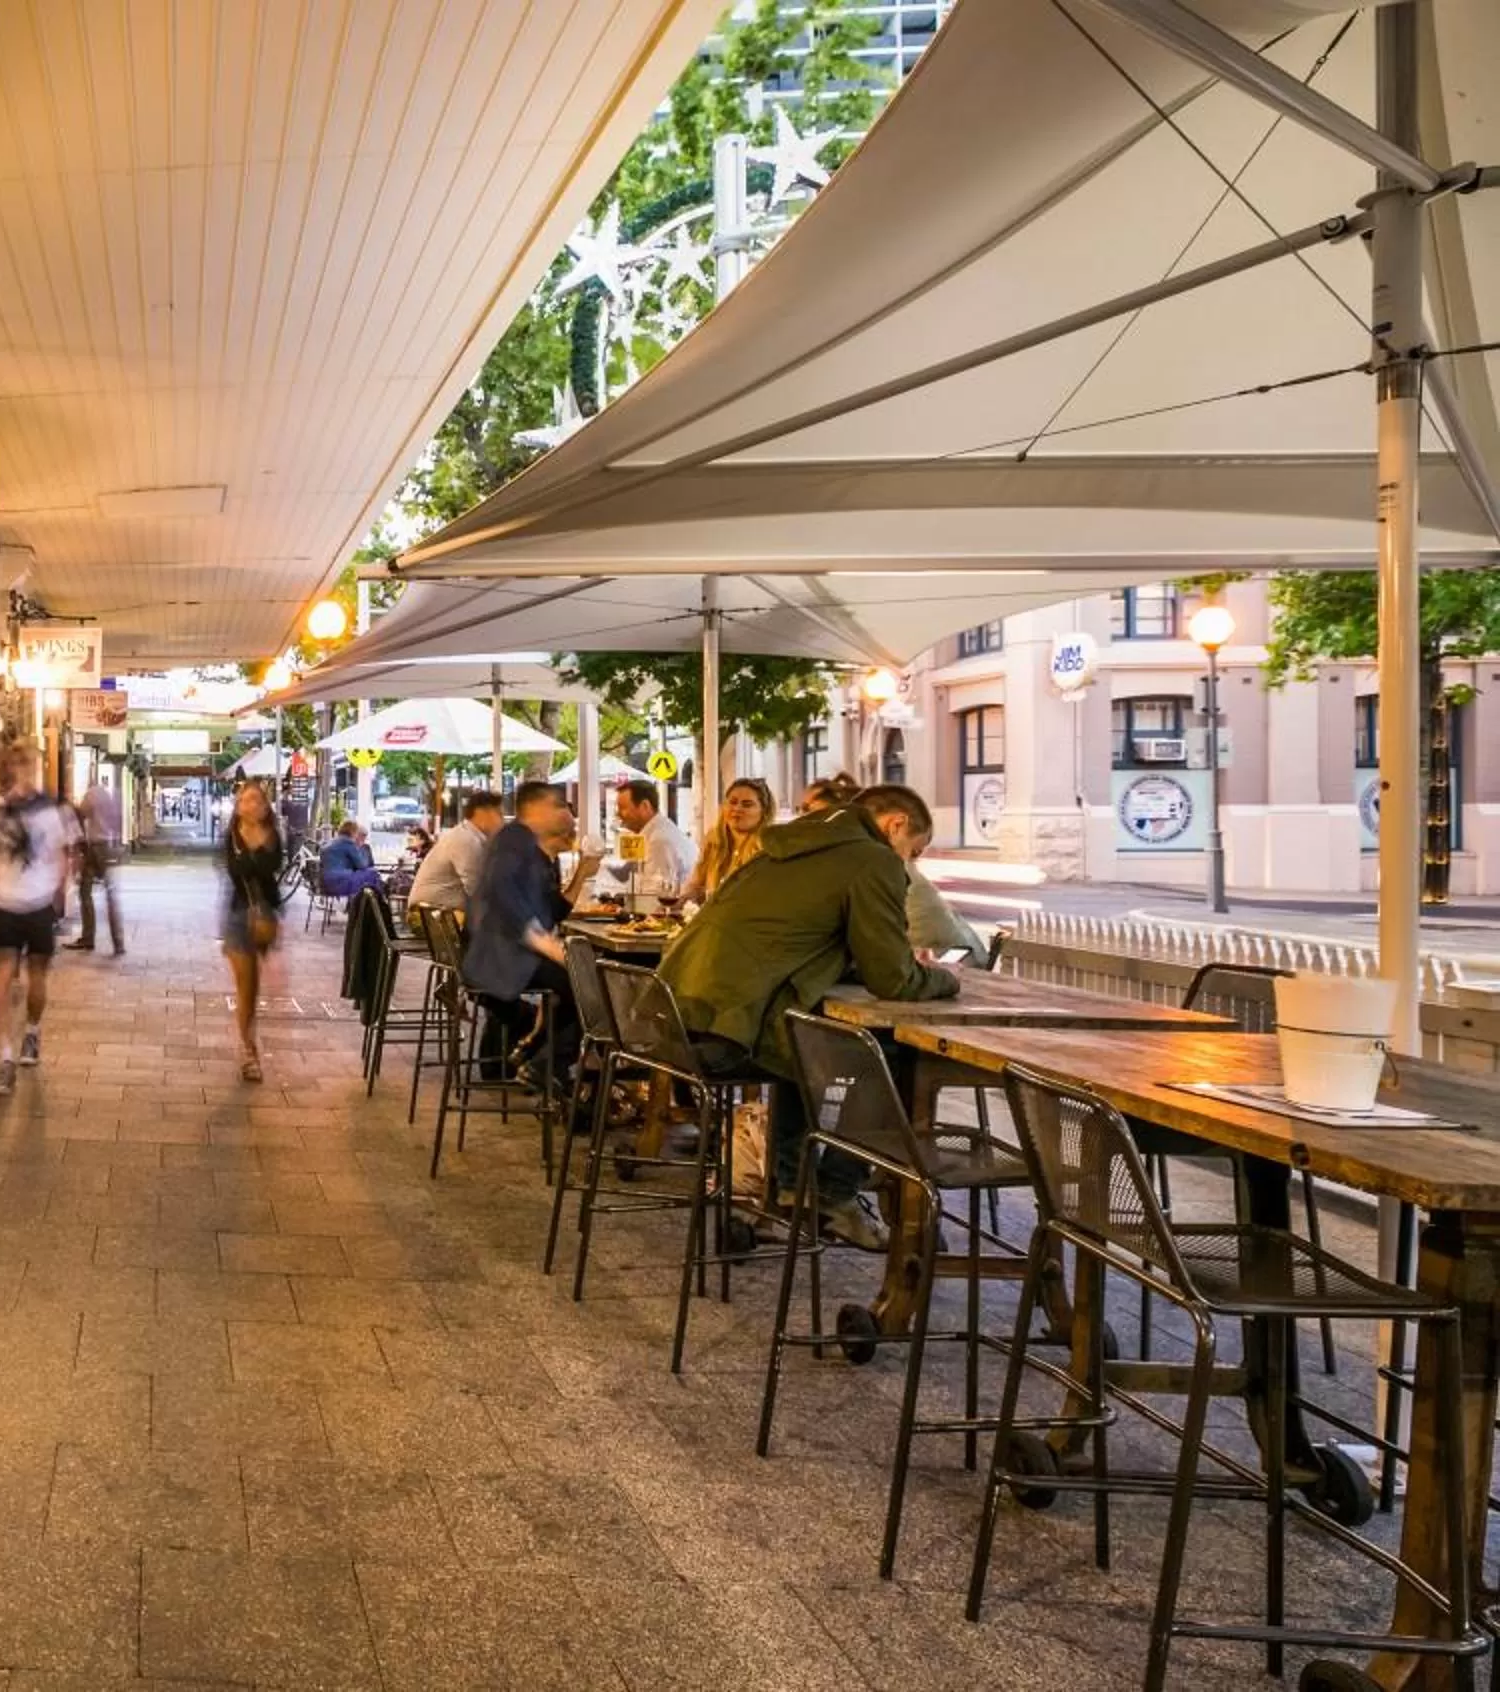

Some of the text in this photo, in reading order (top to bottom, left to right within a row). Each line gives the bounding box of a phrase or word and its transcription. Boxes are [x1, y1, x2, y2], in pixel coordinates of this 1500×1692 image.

[36, 639, 86, 653] WINGS
[1056, 644, 1081, 661] JIM
[1053, 657, 1085, 673] KIDD
